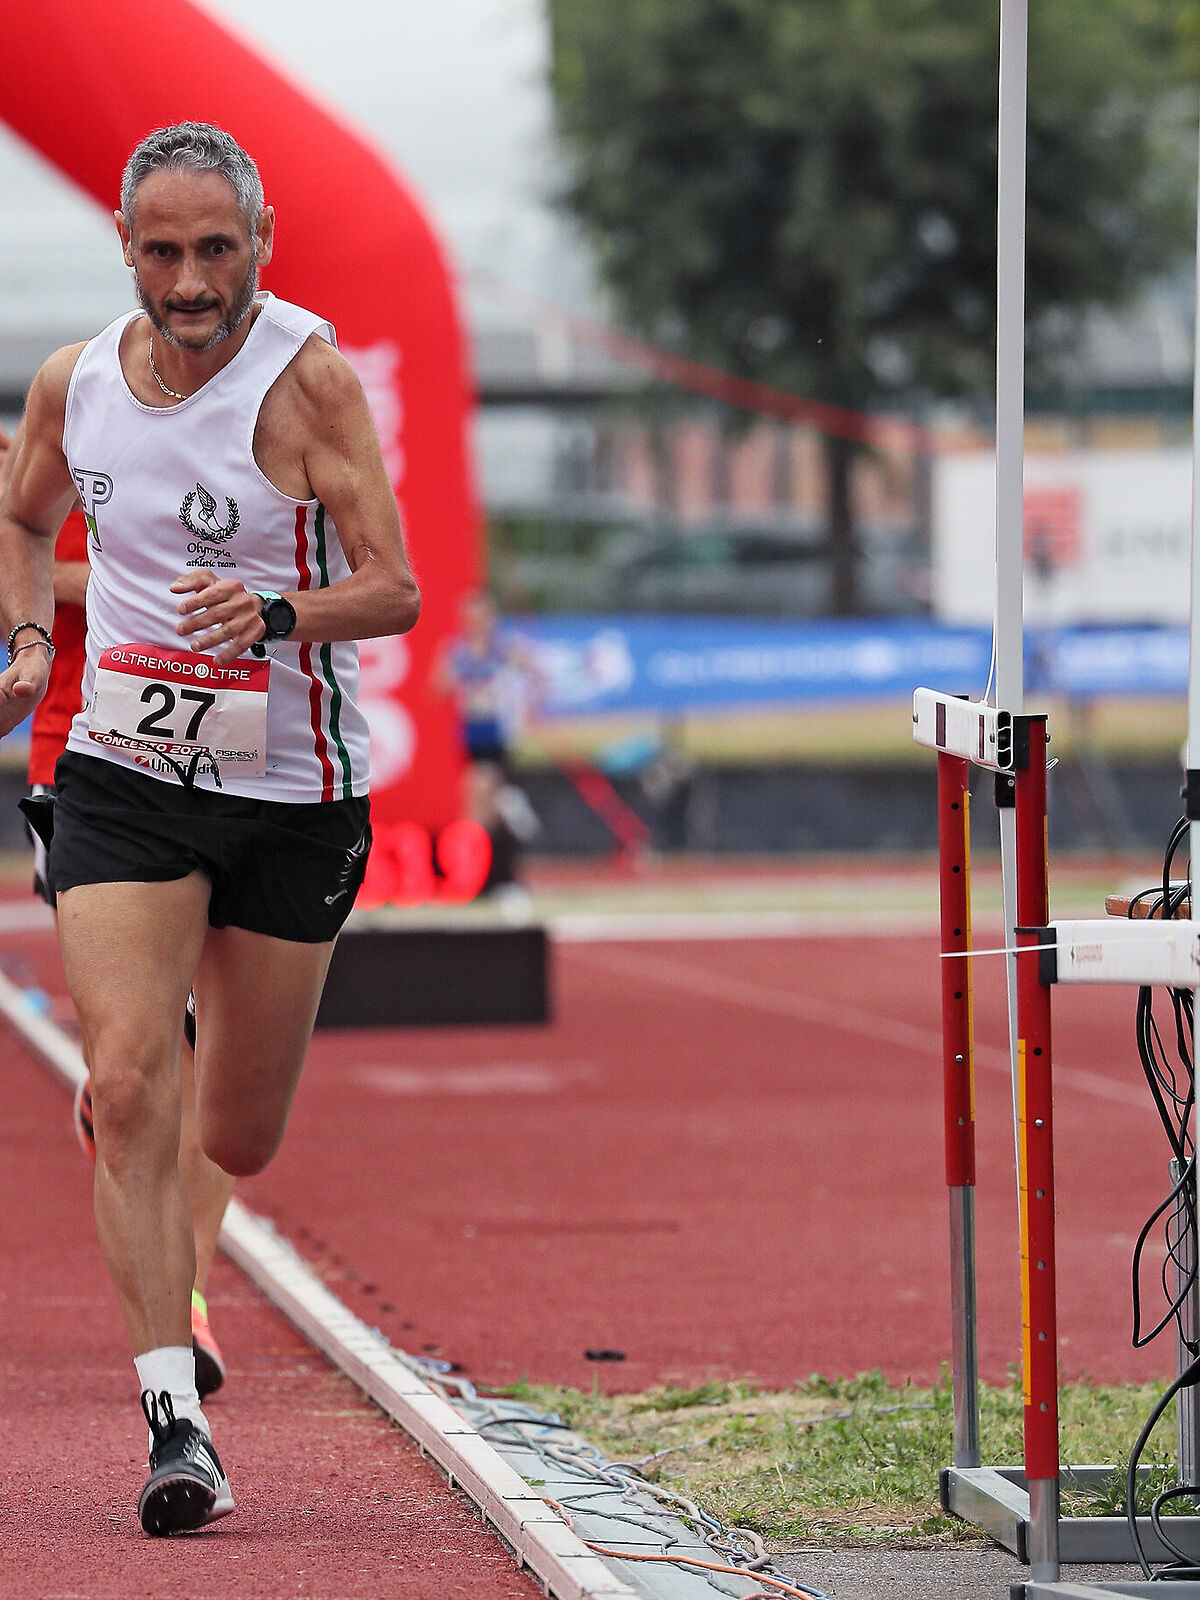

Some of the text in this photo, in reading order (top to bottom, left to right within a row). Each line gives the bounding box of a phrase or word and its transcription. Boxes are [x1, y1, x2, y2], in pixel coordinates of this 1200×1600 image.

[186, 542, 232, 558] Olympia
[186, 558, 237, 568] athletic team
[110, 650, 251, 681] OLTREMODOLTRE
[136, 683, 216, 741] 27
